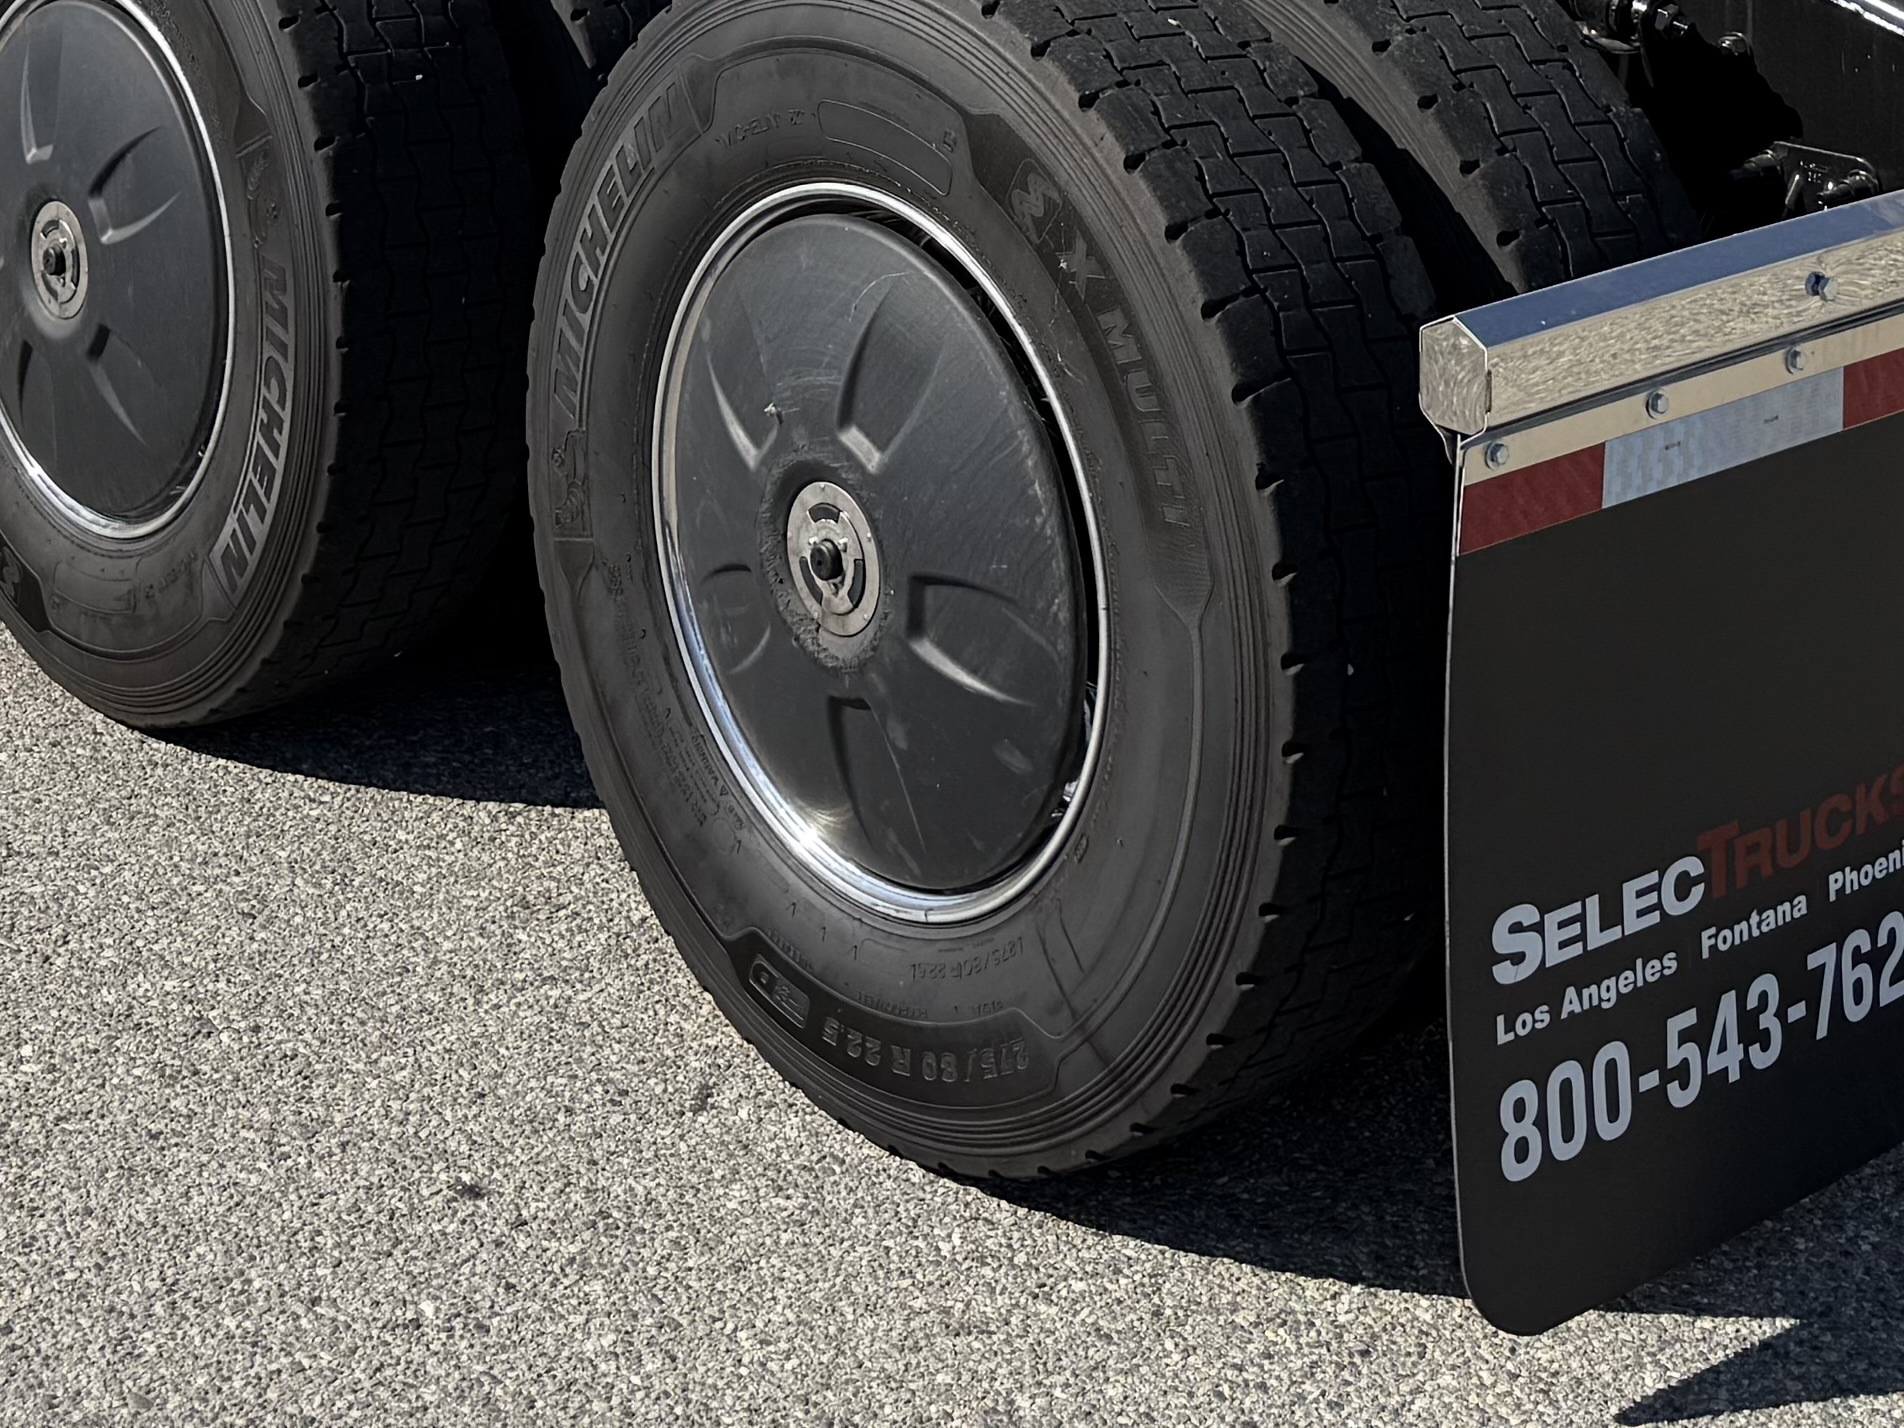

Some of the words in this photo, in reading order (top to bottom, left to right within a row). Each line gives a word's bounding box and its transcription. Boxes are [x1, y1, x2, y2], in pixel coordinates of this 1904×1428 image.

[553, 82, 676, 420] MICHELIN
[220, 256, 290, 596] MICHELIN
[1097, 307, 1194, 528] MULTI
[1496, 1000, 1551, 1045] Los
[1560, 949, 1678, 1020] Angeles
[1700, 893, 1808, 959] Fontana
